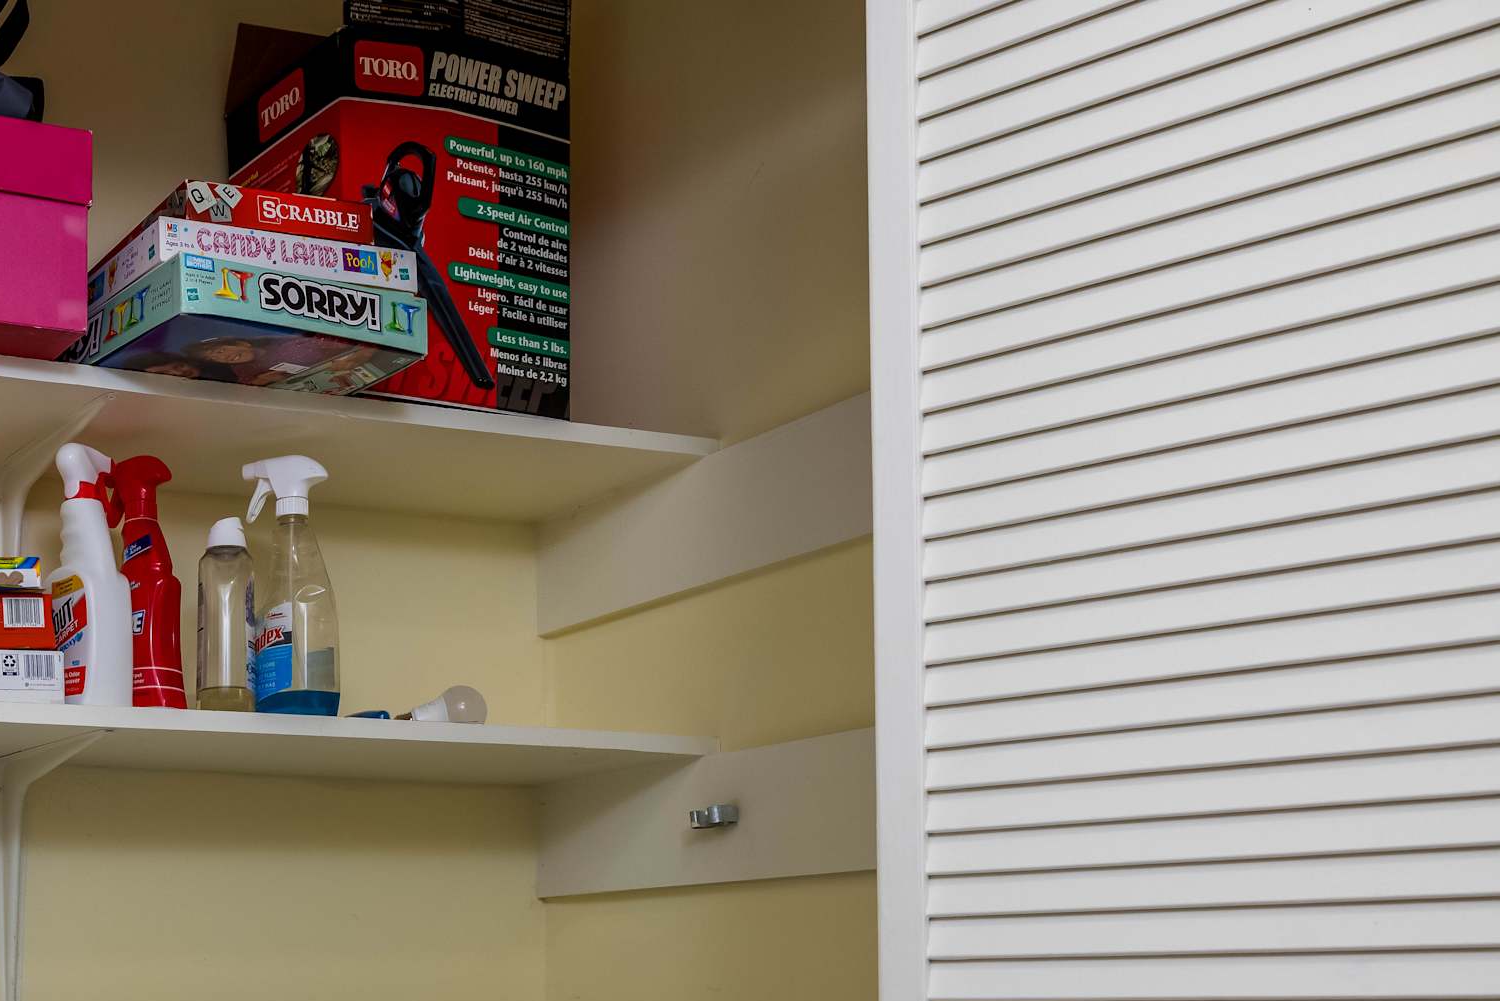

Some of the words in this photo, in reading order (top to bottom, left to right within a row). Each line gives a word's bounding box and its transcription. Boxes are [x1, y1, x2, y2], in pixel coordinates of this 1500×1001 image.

[359, 56, 417, 81] TORO
[429, 50, 503, 94] POWER
[503, 68, 567, 111] SWEEP
[260, 86, 300, 128] TORO
[428, 82, 478, 104] ELECTRIC
[477, 92, 519, 117] BLOWER
[450, 140, 497, 161] Powerful,
[500, 153, 512, 166] up
[515, 155, 525, 166] to
[528, 159, 544, 172] 160
[547, 165, 567, 179] mph
[447, 171, 489, 191] Puissant,
[526, 189, 542, 202] 255
[544, 192, 567, 209] km/h
[456, 158, 496, 177] Potente,
[499, 168, 523, 183] hasta
[526, 174, 542, 188] 255
[544, 178, 568, 195] km/h
[191, 189, 204, 203] Q
[223, 186, 235, 199] E
[211, 205, 225, 217] W
[262, 200, 359, 229] SCRABBLE
[477, 204, 515, 222] 2-Speed
[517, 213, 532, 226] Air
[534, 218, 567, 235] Control
[197, 227, 276, 260] CANDY
[281, 240, 339, 268] LAND
[497, 238, 508, 250] de
[510, 242, 516, 251] 2
[518, 244, 567, 263] velocidades
[503, 227, 536, 244] Control
[538, 235, 549, 246] de
[551, 237, 567, 251] aire
[344, 252, 375, 271] Pooh
[469, 247, 494, 261] Débit
[519, 255, 525, 267] à
[527, 260, 533, 270] 2
[535, 262, 567, 277] vitesses
[454, 266, 516, 289] Lightweight,
[518, 283, 538, 295] easy
[540, 285, 550, 295] to
[553, 289, 567, 299] use
[263, 278, 376, 326] SORRY!
[469, 301, 494, 315] Léger
[502, 308, 528, 322] Facile
[529, 312, 535, 323] à
[537, 316, 567, 330] utiliser
[478, 288, 509, 303] Ligero.
[514, 295, 533, 310] Fácil
[536, 299, 547, 311] de
[549, 305, 567, 315] usar
[497, 332, 516, 345] Less
[518, 335, 540, 349] than
[543, 340, 548, 350] 5
[551, 341, 567, 354] lbs.
[490, 348, 519, 363] Menos
[521, 354, 533, 365] de
[534, 356, 541, 366] 5
[543, 357, 567, 370] libras
[497, 364, 524, 378] Moins
[526, 369, 538, 380] de
[539, 371, 553, 383] 2,2
[556, 374, 567, 387] kg
